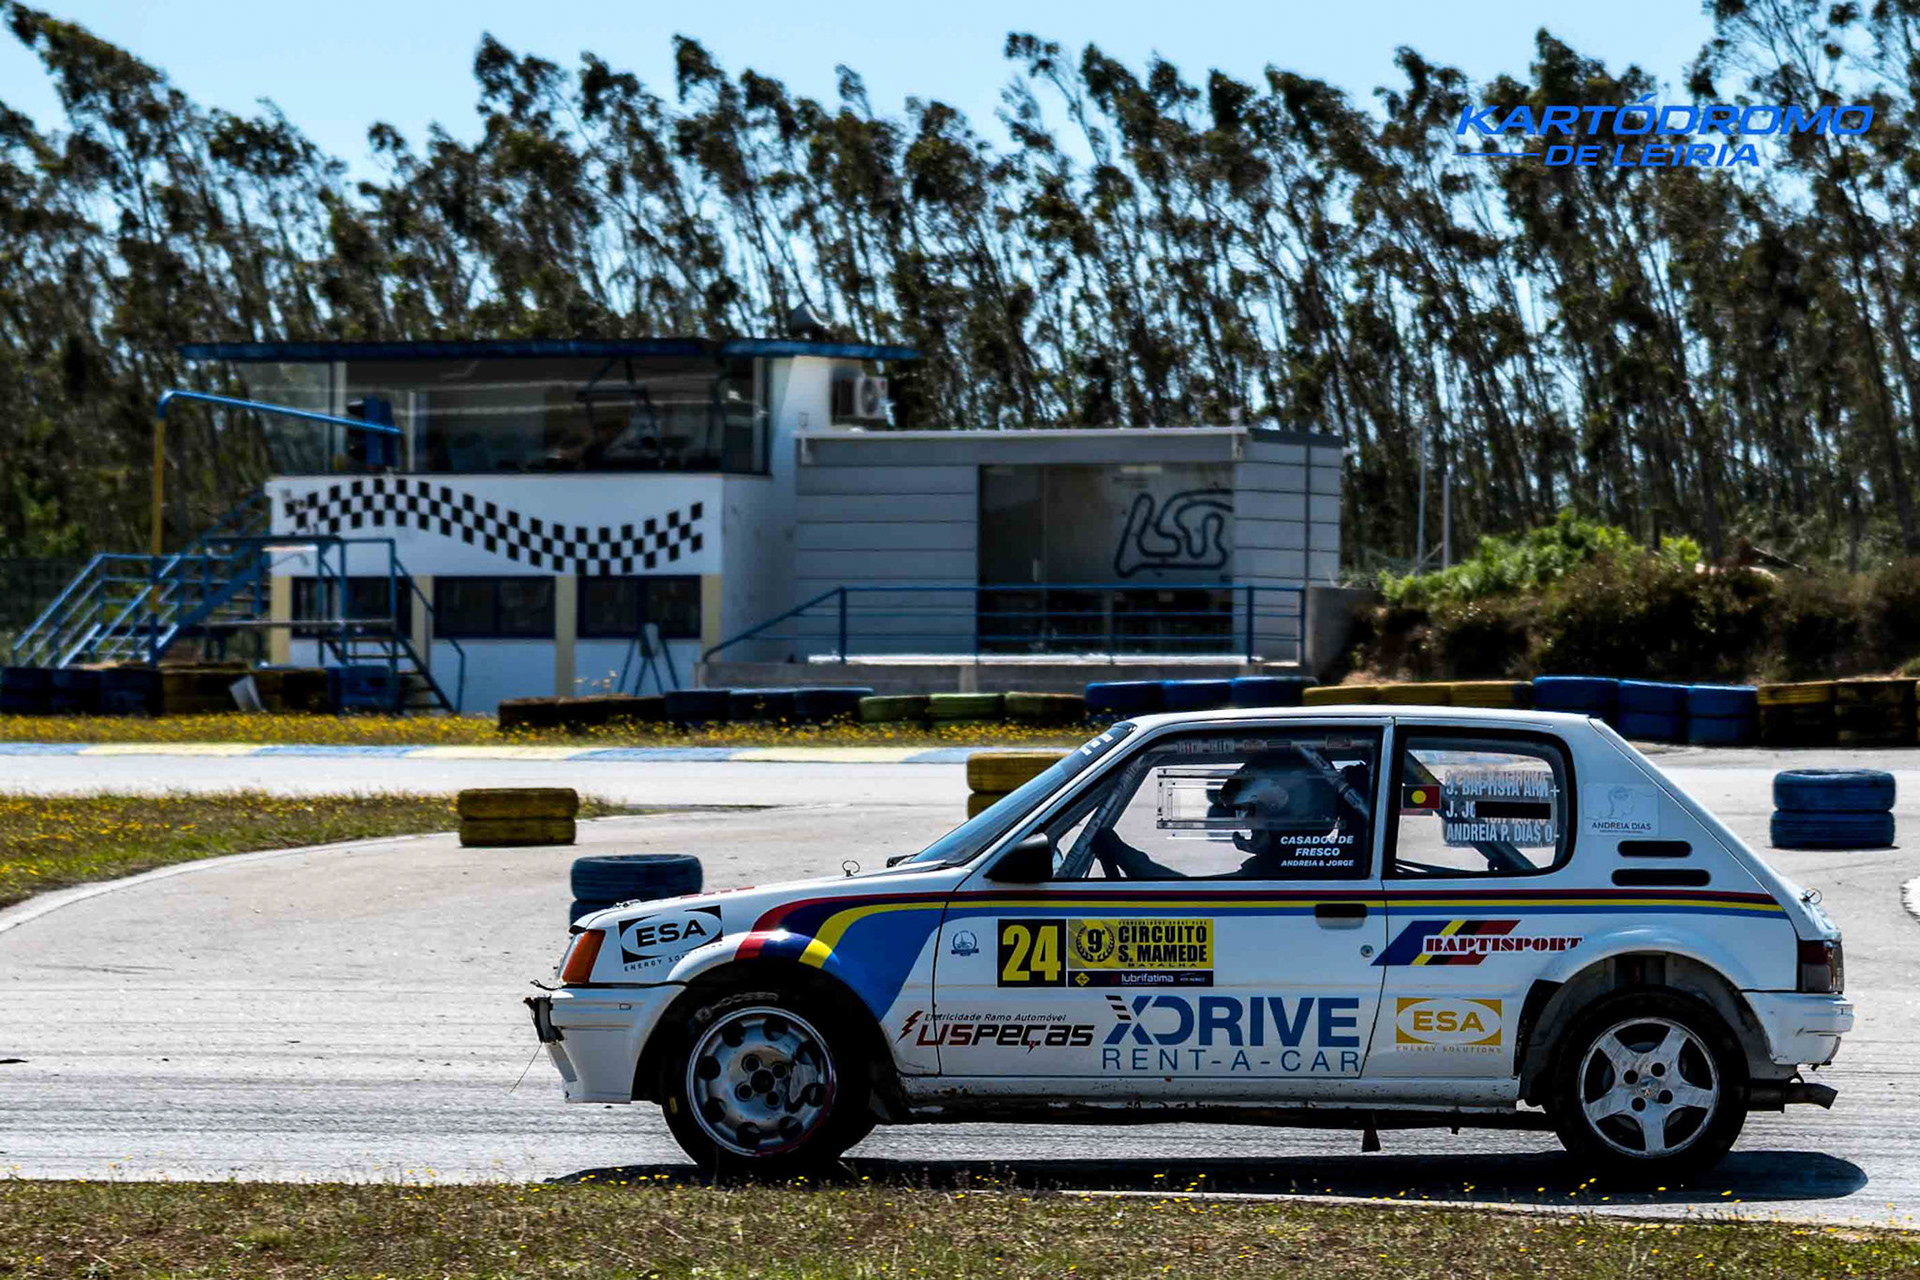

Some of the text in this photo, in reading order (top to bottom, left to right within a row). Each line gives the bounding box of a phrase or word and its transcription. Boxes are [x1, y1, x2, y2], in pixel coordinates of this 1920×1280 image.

[1446, 822, 1498, 841] ANDREIA
[1501, 823, 1510, 841] P.
[1514, 823, 1541, 842] DIAS
[1591, 822, 1652, 831] ANDREIA DIAS
[1338, 835, 1354, 844] DE
[1295, 847, 1341, 857] FRESCO
[1280, 859, 1318, 867] ANDREIA
[1326, 859, 1354, 867] JORGE
[635, 919, 707, 948] ESA
[1118, 925, 1207, 943] CIRCUITO
[1425, 937, 1583, 952] BAPTISPORT
[1002, 924, 1061, 982] 24
[1118, 944, 1207, 963] S. MAMEDE
[624, 958, 663, 973] ENERGY
[1121, 973, 1174, 983] lubrifatima
[985, 1013, 1011, 1022] Ramo
[1014, 1012, 1066, 1022] Automóvel
[1103, 995, 1360, 1048] XDRIVE
[1412, 1010, 1485, 1033] ESA
[1102, 1049, 1360, 1072] RENT-A-CAR
